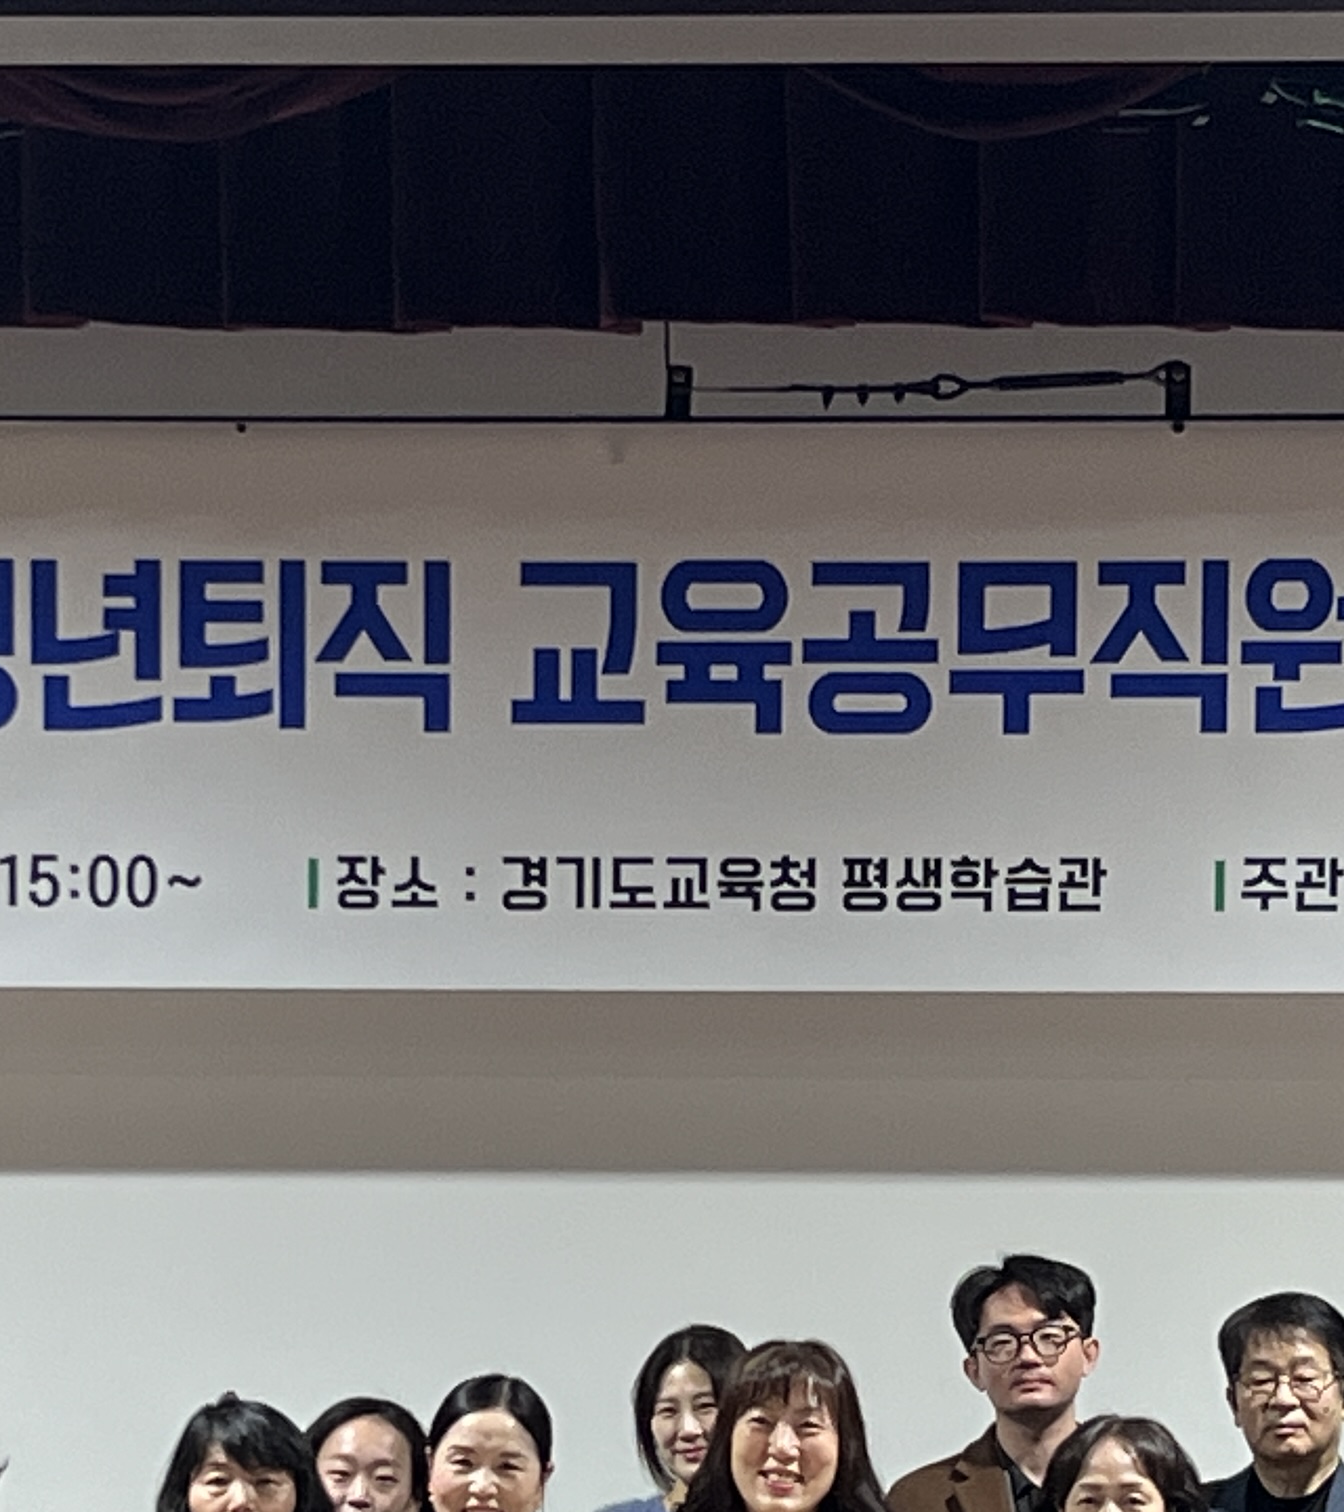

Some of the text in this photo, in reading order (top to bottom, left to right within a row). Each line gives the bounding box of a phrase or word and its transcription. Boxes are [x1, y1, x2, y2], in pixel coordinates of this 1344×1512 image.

[336, 854, 1108, 913] 장소 : 경기도교육청 평생학습관
[1240, 856, 1344, 913] 주관
